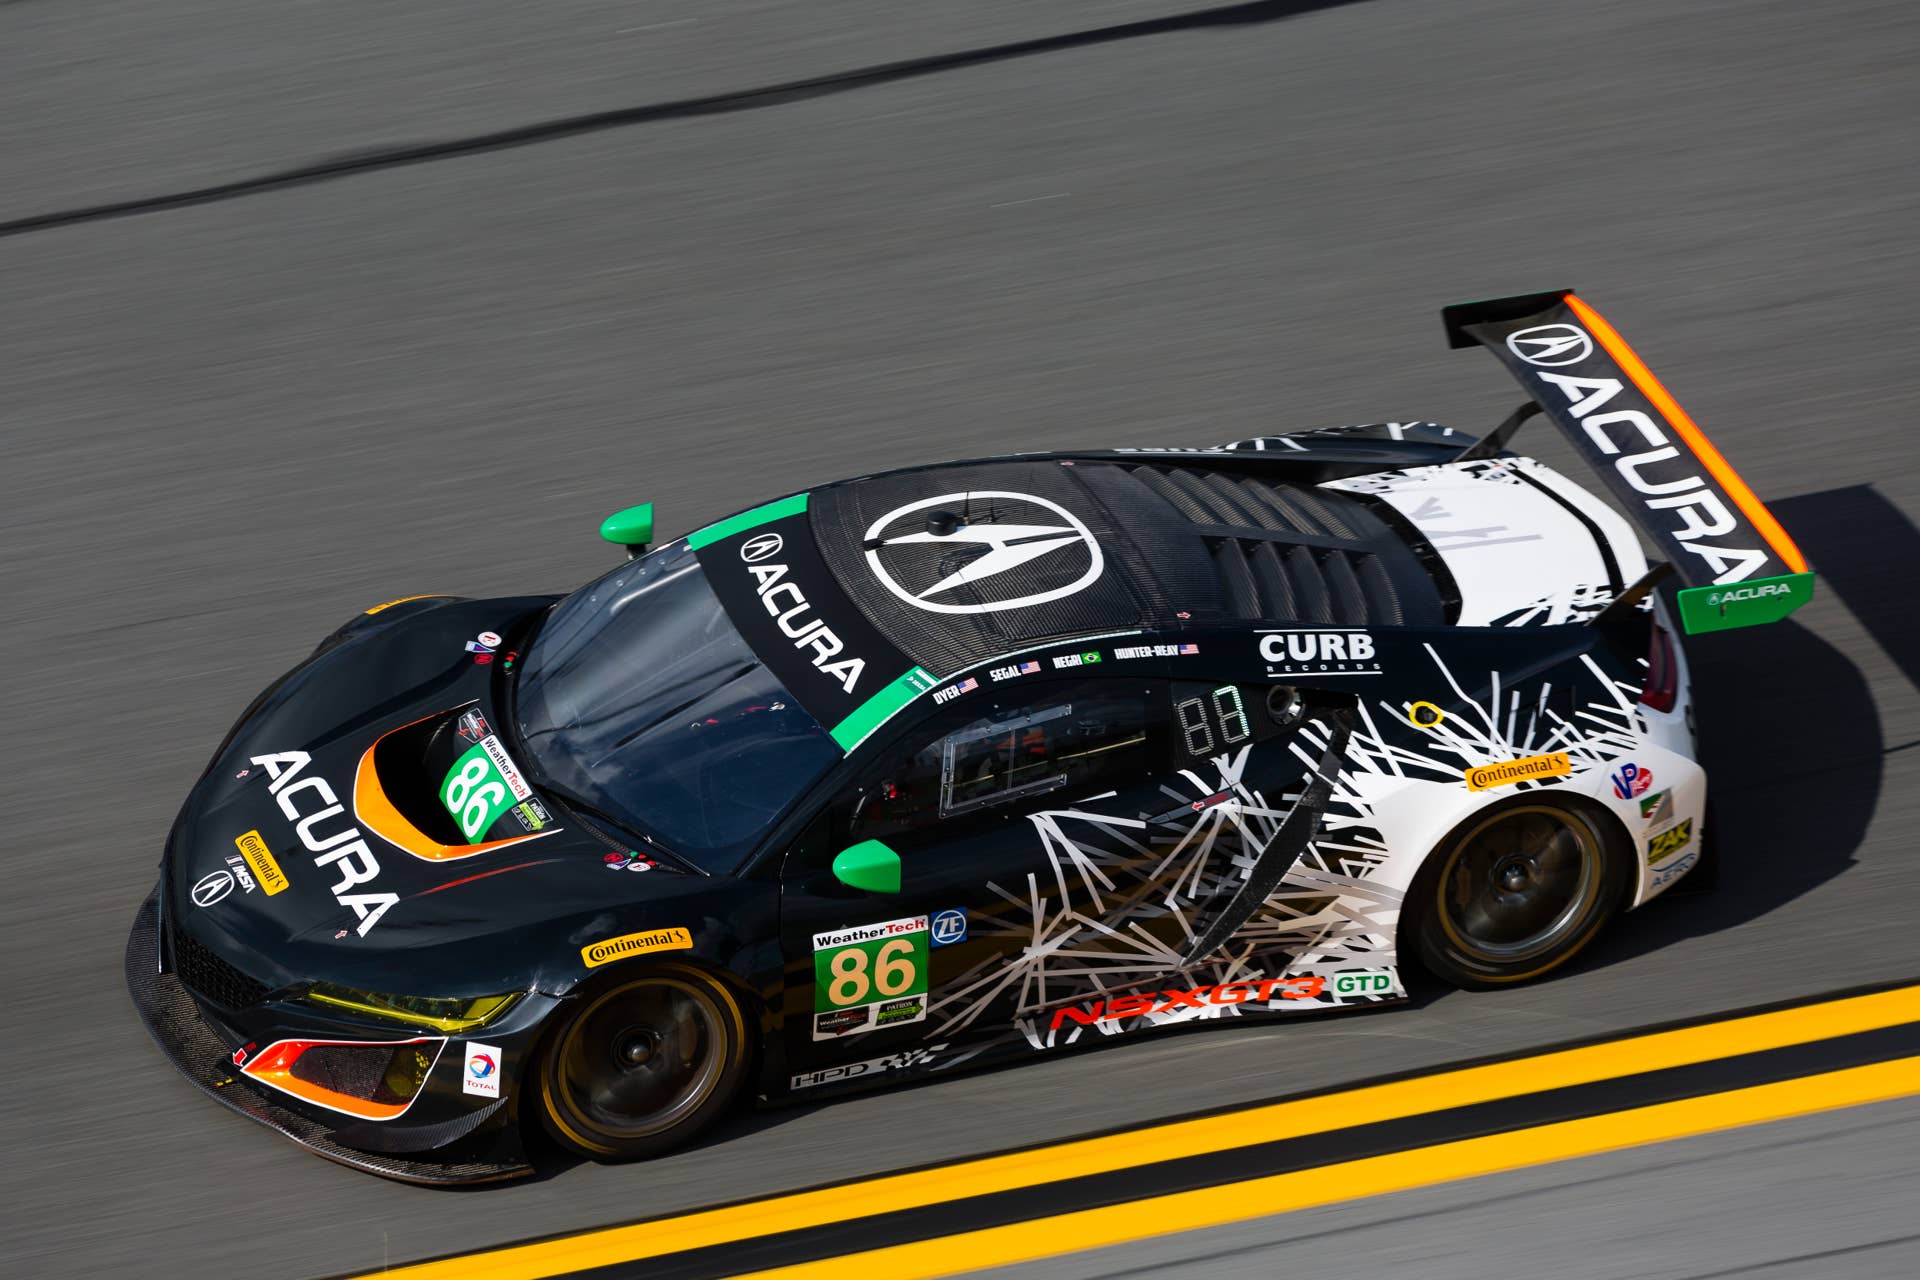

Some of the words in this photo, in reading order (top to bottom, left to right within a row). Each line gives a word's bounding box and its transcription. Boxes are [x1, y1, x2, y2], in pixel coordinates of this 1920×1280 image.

[1536, 371, 1769, 586] ACURA
[1720, 583, 1791, 603] ACURA
[748, 562, 867, 694] ACURA
[1052, 654, 1083, 669] NEGRI
[1114, 644, 1179, 660] HUNTER-REAY
[1259, 634, 1376, 662] CURB
[989, 665, 1022, 682] SEGAL
[1266, 663, 1381, 673] RECORDS
[932, 684, 961, 705] DYER
[484, 738, 527, 798] WeatherTech
[1471, 757, 1552, 788] Continental
[1611, 763, 1638, 799] VP
[446, 757, 506, 838] 86
[250, 750, 400, 937] ACURA
[240, 835, 280, 883] Continental
[231, 865, 256, 894] IMSA
[589, 931, 673, 962] Continental
[816, 919, 926, 947] WeatherTech
[828, 939, 916, 1006] 86
[1337, 974, 1390, 994] GTD
[466, 1080, 496, 1091] TOTAL
[795, 1063, 869, 1087] HPD
